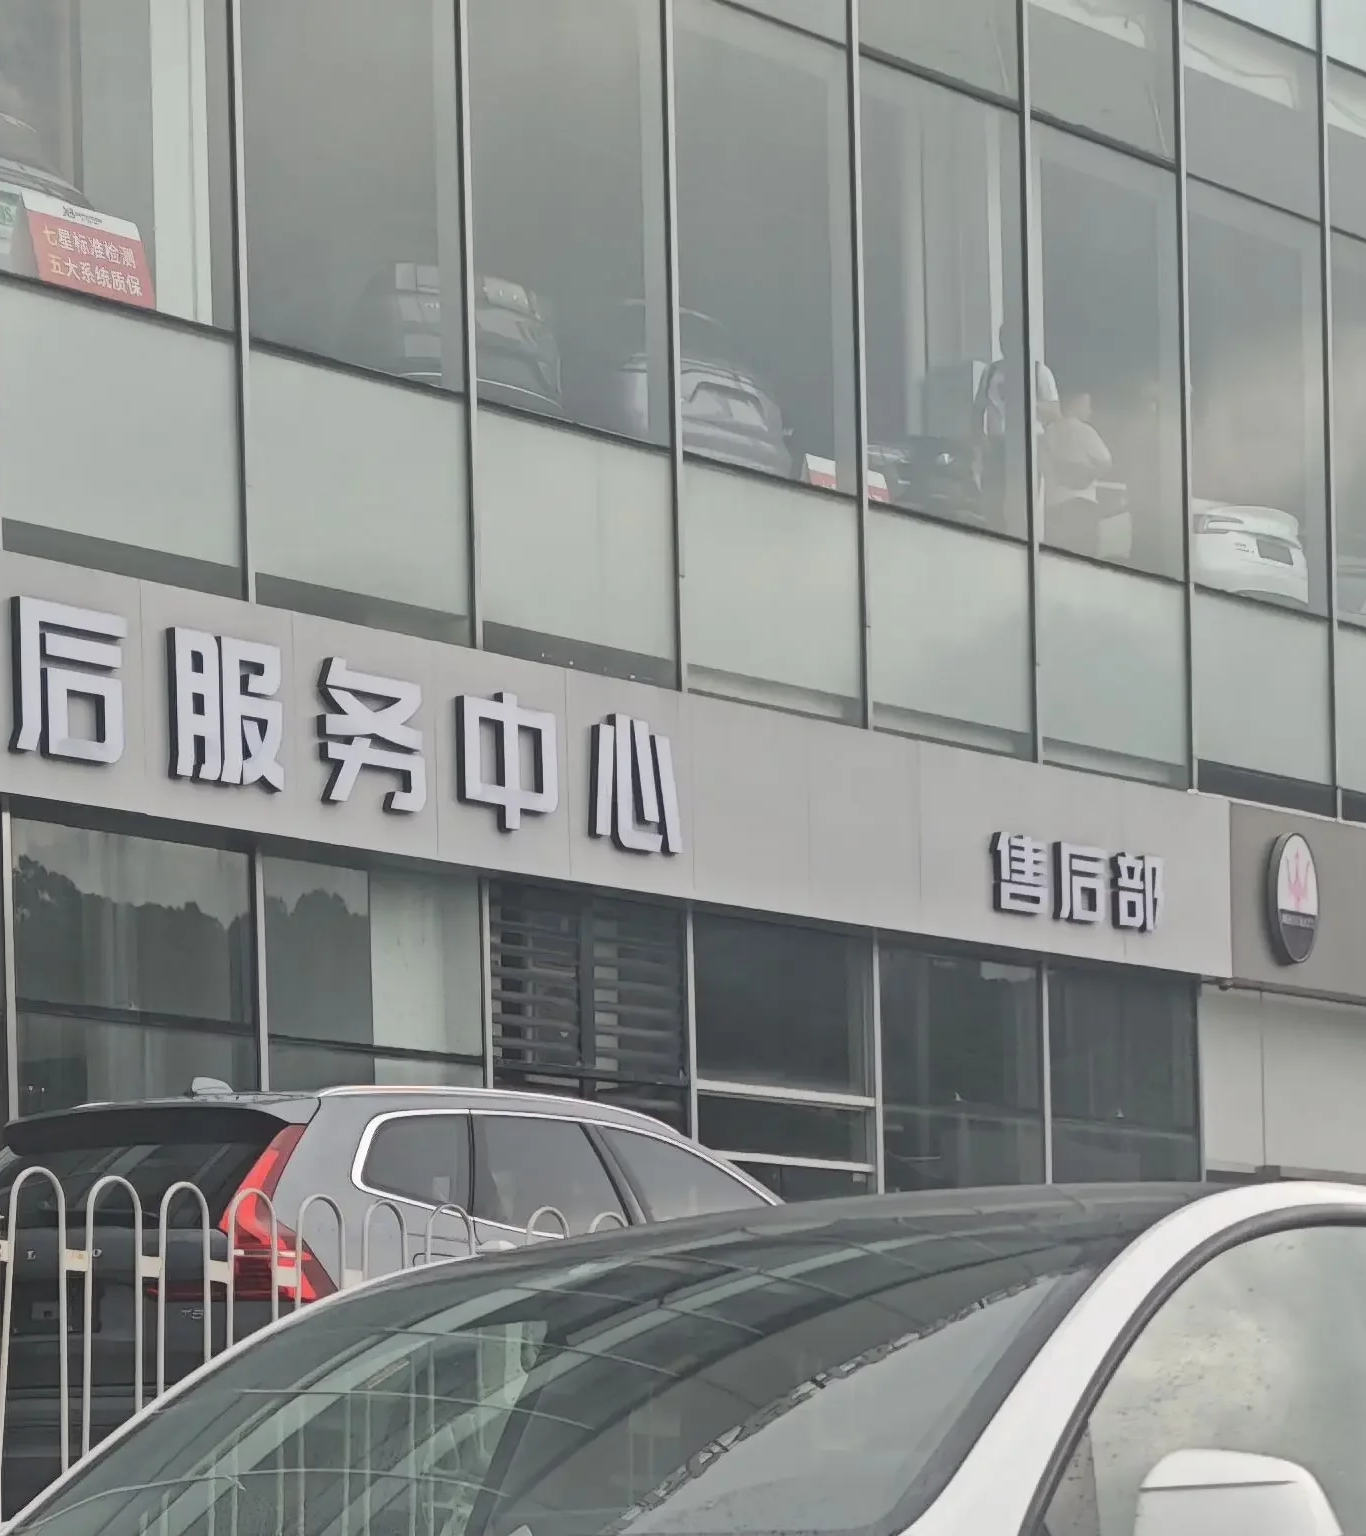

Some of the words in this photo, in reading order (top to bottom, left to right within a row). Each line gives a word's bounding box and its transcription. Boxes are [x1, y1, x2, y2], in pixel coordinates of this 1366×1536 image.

[43, 224, 137, 269] 七星标准检测
[48, 254, 143, 297] 五大系统质保
[990, 830, 1165, 932] 售后部
